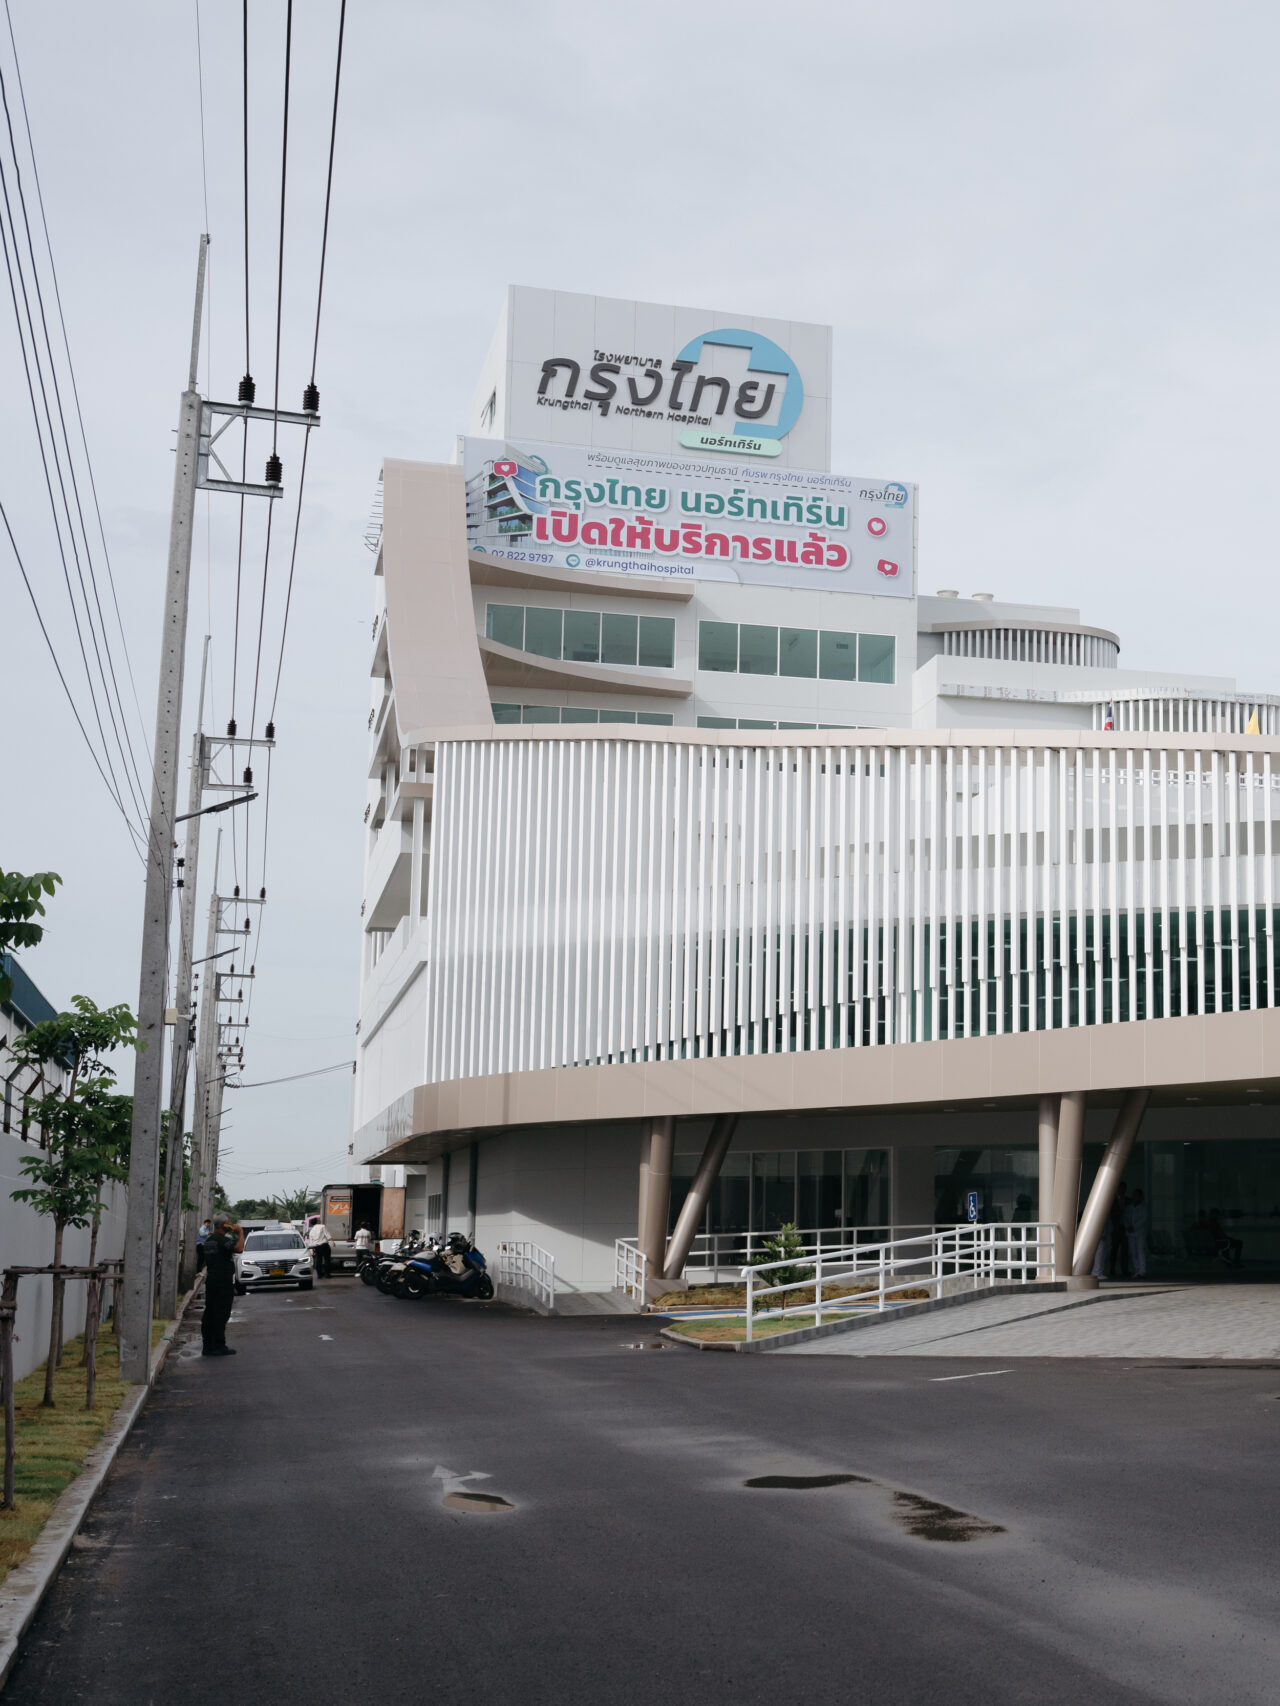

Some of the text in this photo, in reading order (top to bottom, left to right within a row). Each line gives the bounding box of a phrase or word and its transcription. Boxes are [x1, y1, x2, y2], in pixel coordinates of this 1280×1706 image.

[593, 350, 662, 369] โรงพยาบาล
[537, 357, 775, 418] กรุงไทย
[536, 396, 712, 426] Krungthai Northern Hospital
[700, 435, 762, 451] นอร์ทเทิร์น
[539, 477, 845, 527] กรุงไทย นอร์ทเทิร์น
[859, 489, 904, 502] กรุงไทย
[535, 510, 848, 568] เปิดให้บริการแล้ว
[507, 551, 526, 561] 822
[529, 552, 554, 564] 9797
[585, 557, 695, 575] @krungthaihospital
